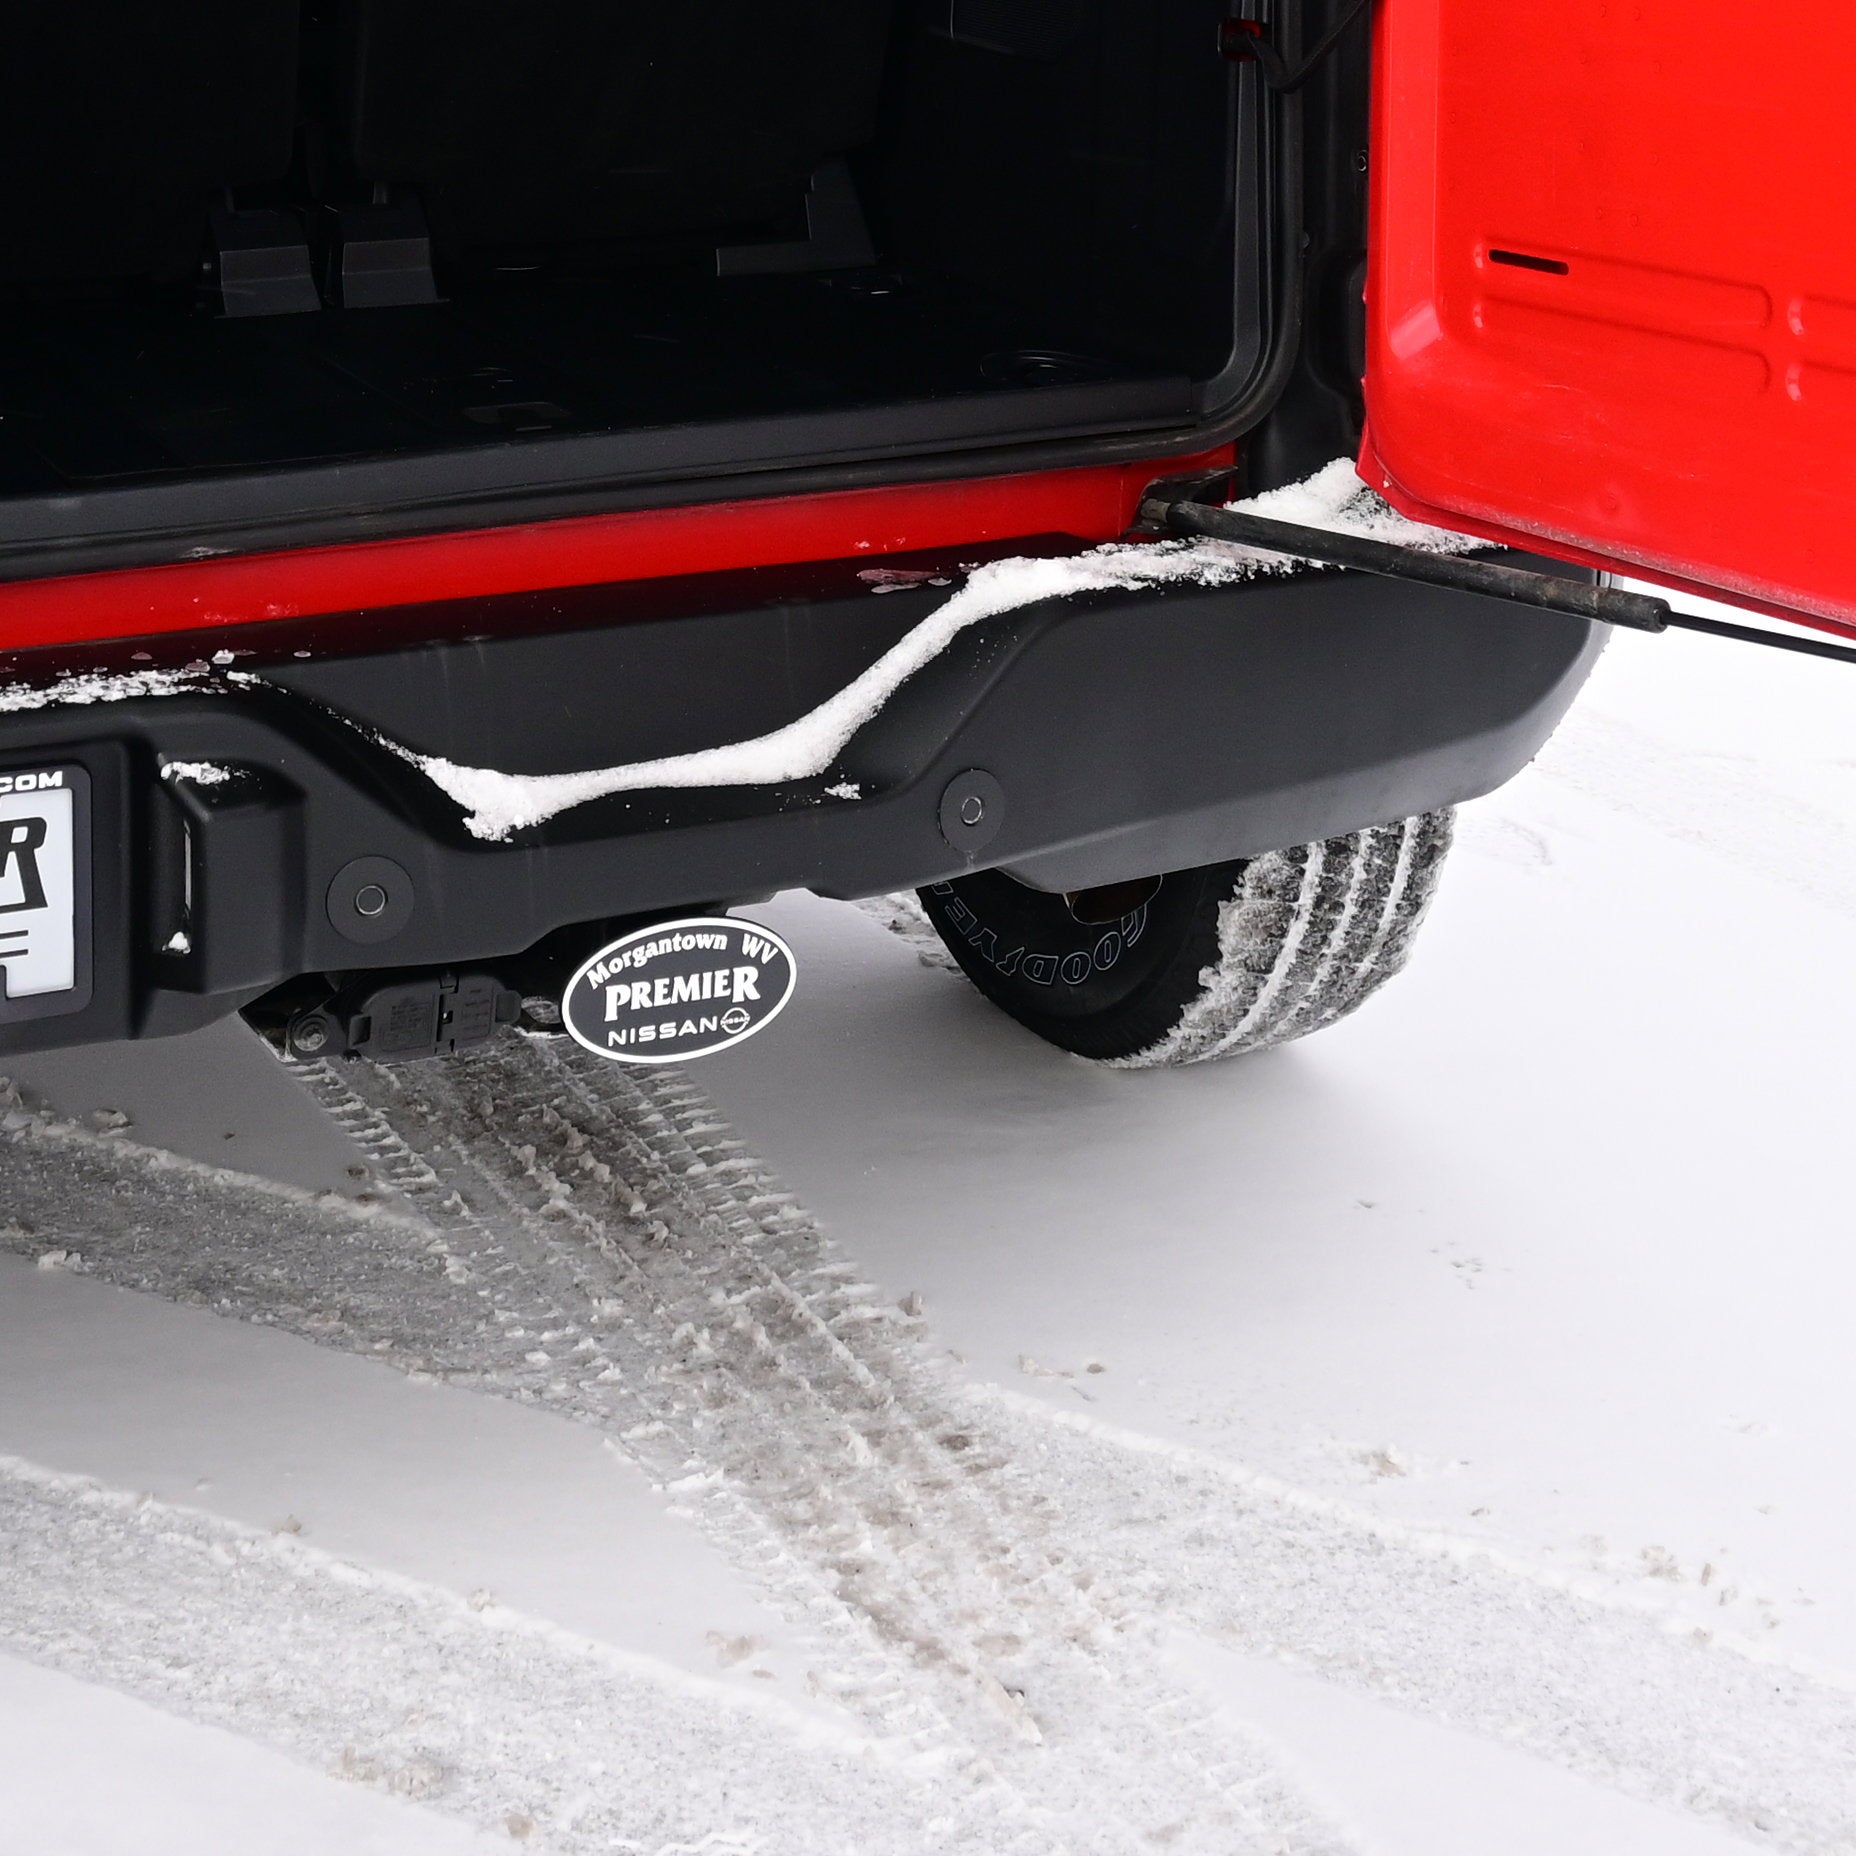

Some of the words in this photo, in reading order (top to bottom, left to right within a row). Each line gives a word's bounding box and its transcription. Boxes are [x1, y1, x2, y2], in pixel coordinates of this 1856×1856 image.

[586, 932, 728, 990] Morgantown
[741, 932, 779, 965] WV
[604, 965, 761, 1022] PREMIER
[608, 1015, 718, 1047] NISSAN
